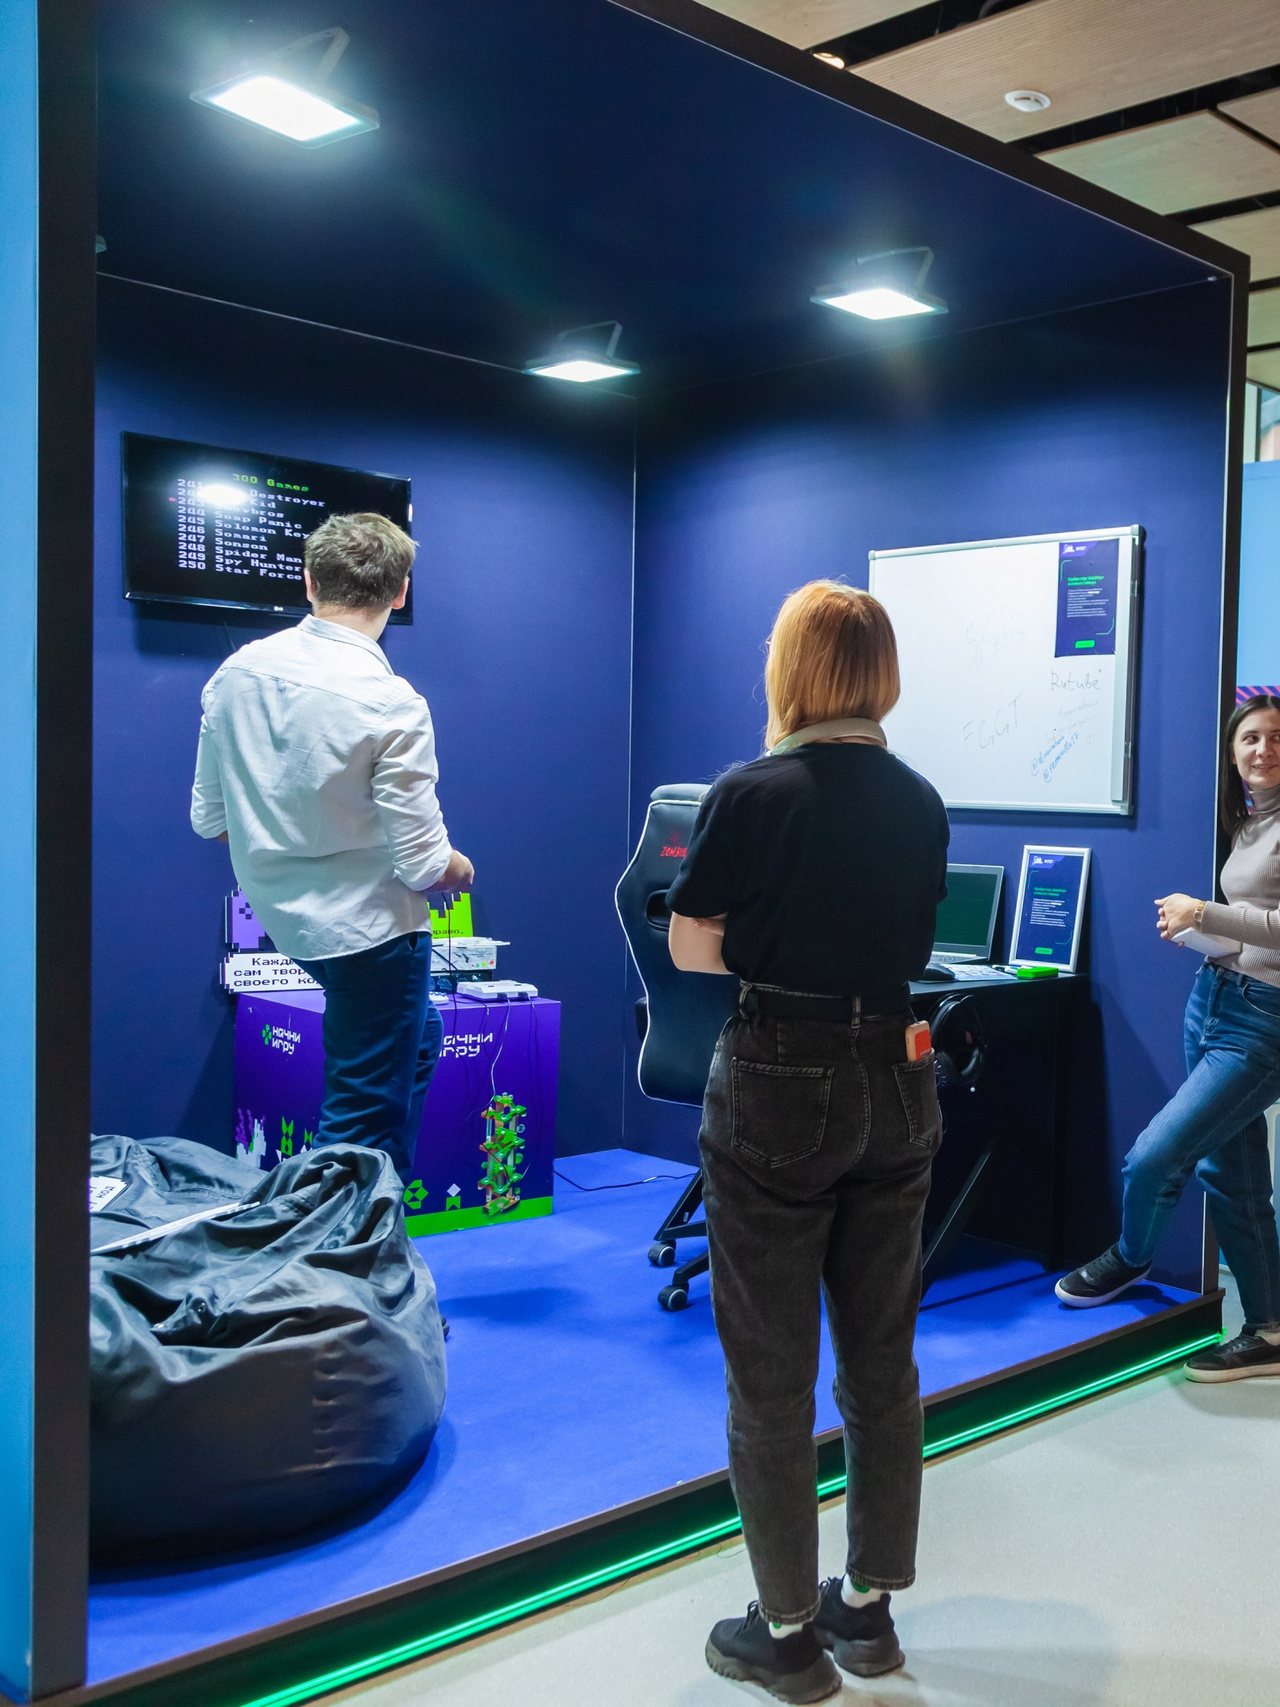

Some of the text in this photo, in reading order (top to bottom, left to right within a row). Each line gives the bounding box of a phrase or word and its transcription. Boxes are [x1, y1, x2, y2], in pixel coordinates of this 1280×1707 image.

[233, 474, 309, 492] 300 Games
[249, 489, 326, 507] Destroyer
[178, 506, 302, 529] 244 Soap Panic
[178, 515, 205, 525] 245
[214, 519, 277, 535] Solomon
[178, 524, 267, 542] 246 Somari
[178, 533, 268, 551] 247 Sonson
[178, 542, 303, 564] 248 Spider Man
[178, 551, 302, 572] 249 Spy Hunter
[178, 560, 303, 581] 250 Star Force
[234, 977, 319, 987] своего ко
[443, 1032, 494, 1046] ачни
